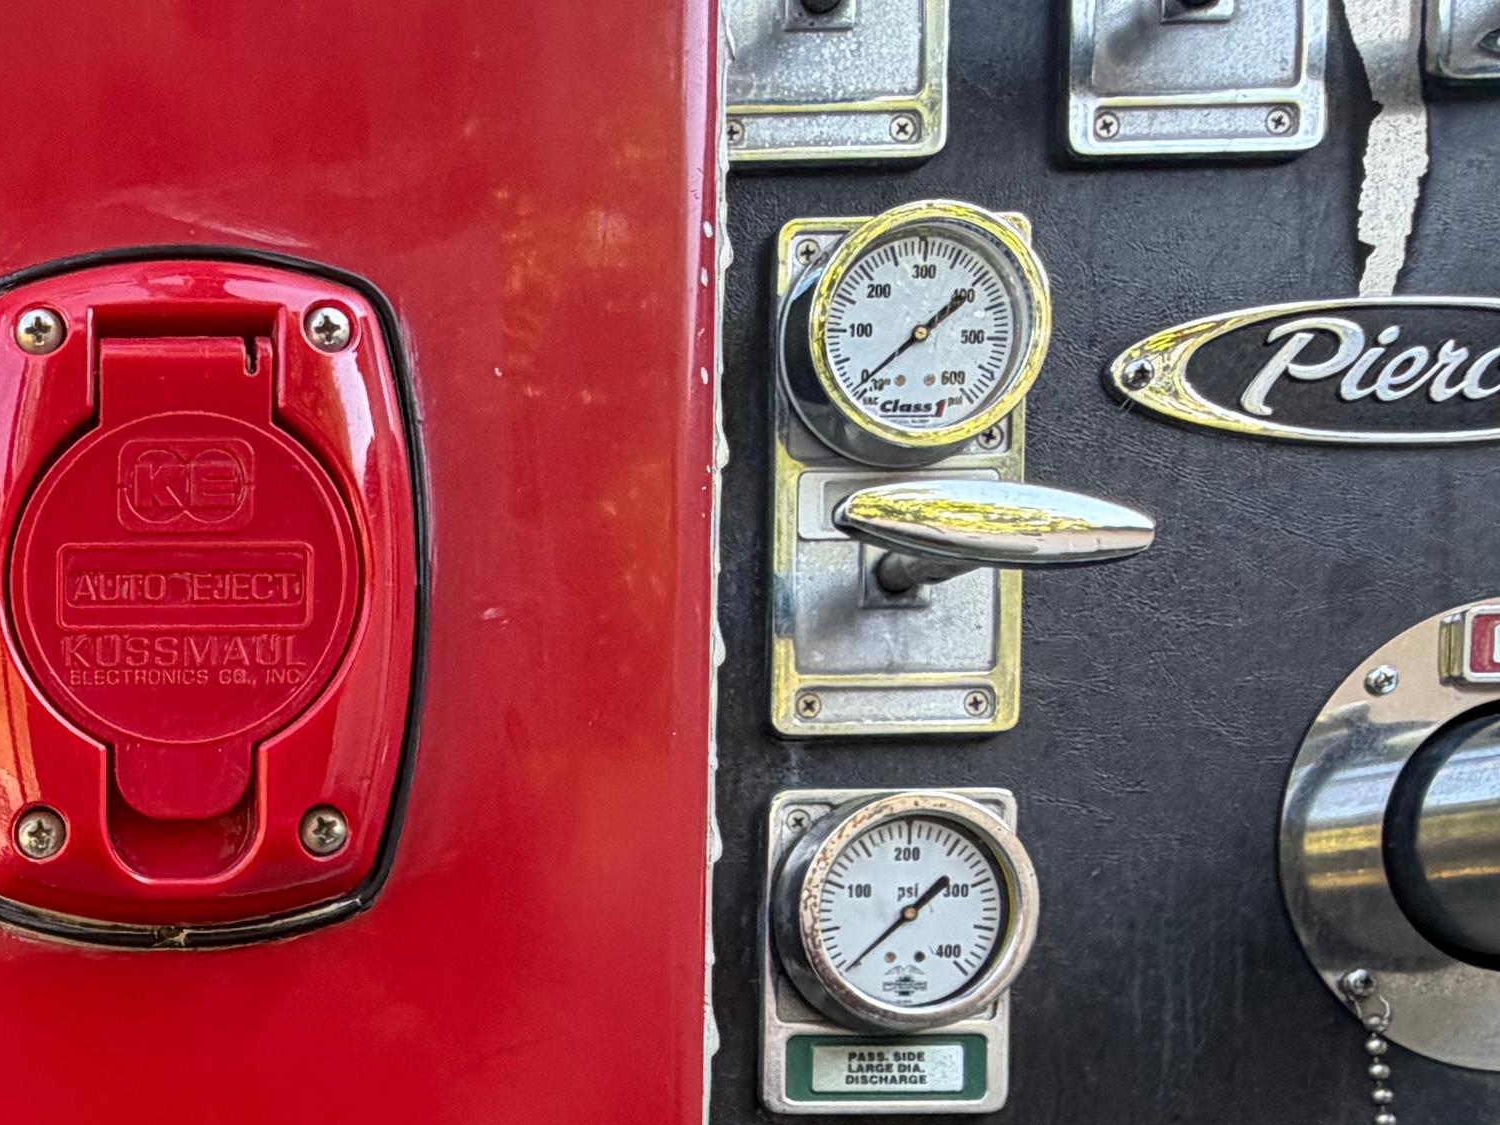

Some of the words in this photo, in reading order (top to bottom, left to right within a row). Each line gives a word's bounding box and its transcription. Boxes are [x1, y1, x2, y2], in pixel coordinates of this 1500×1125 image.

[912, 264, 936, 279] 300
[867, 284, 891, 299] 200
[952, 288, 975, 303] 400
[849, 323, 872, 338] 100
[961, 329, 985, 344] 500
[941, 371, 965, 385] 600
[73, 573, 167, 601] AUTO
[193, 573, 297, 600] EJECT
[61, 634, 307, 668] KUSSMAUL
[70, 668, 208, 686] ELECTRONICS
[894, 847, 920, 861] 200
[848, 884, 871, 898] 100
[897, 883, 919, 902] psi
[943, 883, 969, 898] 300
[936, 944, 961, 959] 400
[848, 1052, 889, 1062] PASS.
[893, 1052, 925, 1062] SIDE
[847, 1063, 894, 1073] LARGE
[897, 1063, 925, 1073] DIA.
[845, 1075, 927, 1085] DISCHARGE
